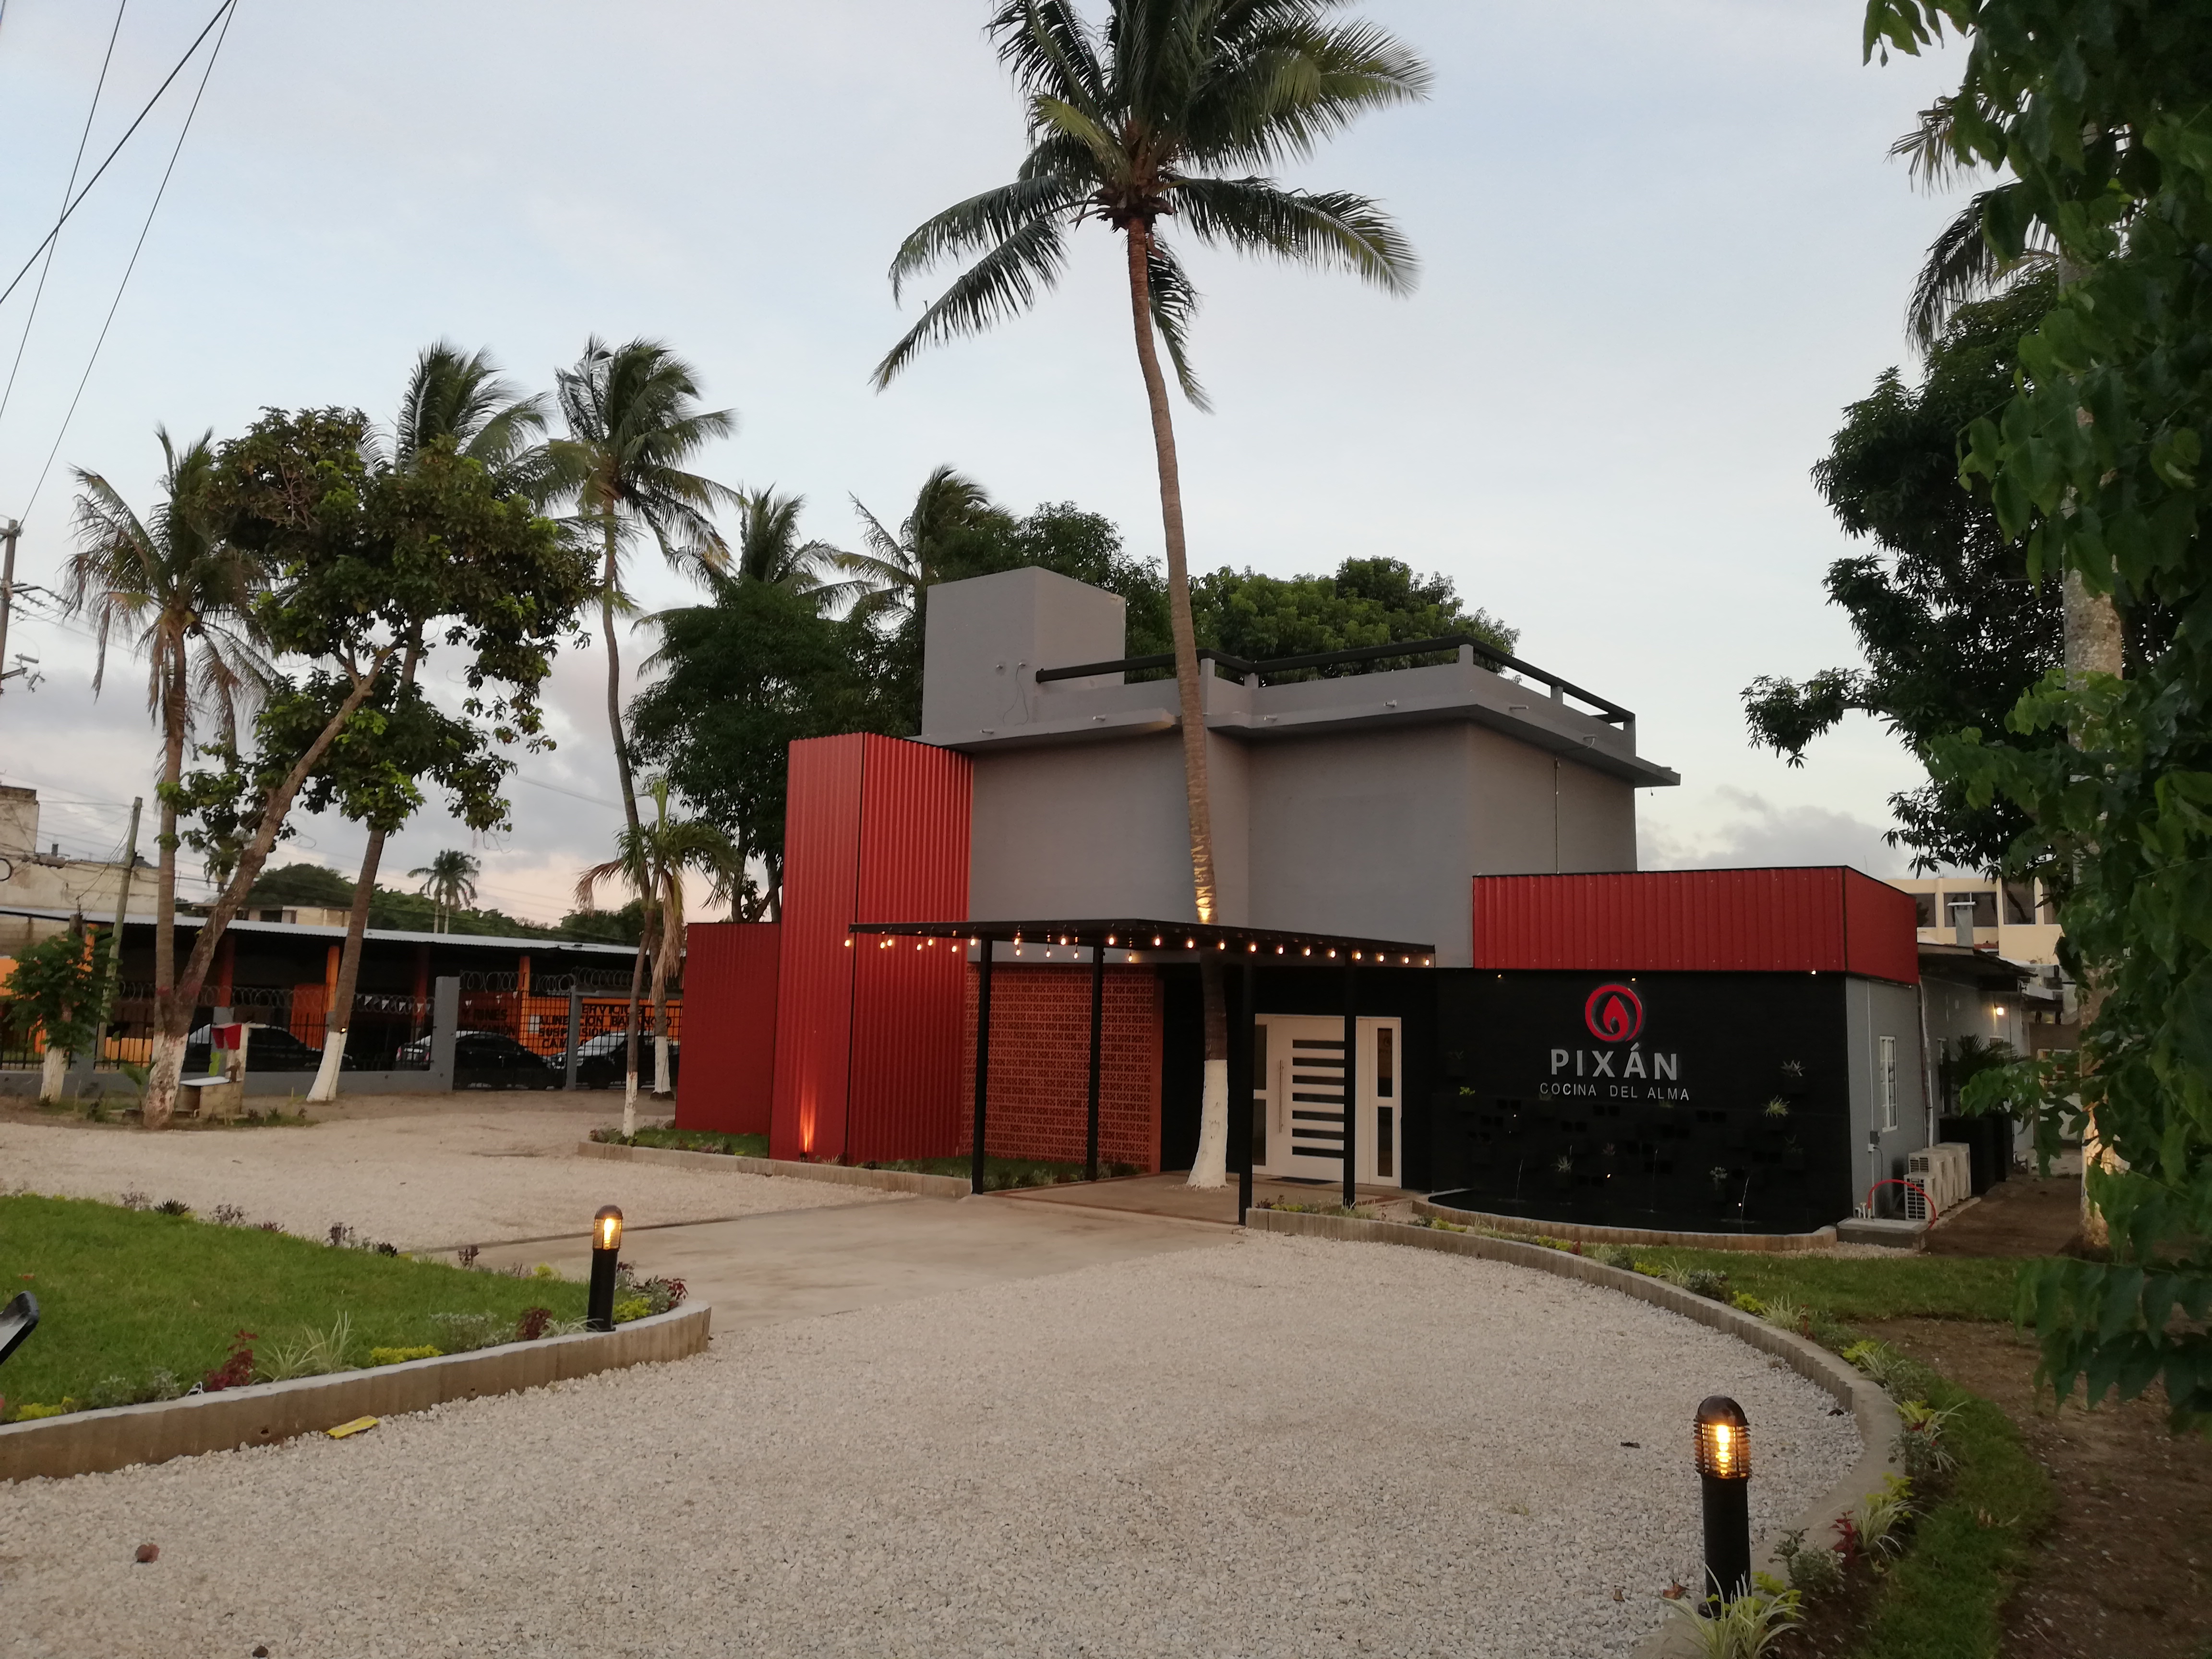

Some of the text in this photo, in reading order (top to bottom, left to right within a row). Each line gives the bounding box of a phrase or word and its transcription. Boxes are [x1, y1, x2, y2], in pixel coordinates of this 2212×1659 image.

[1551, 1042, 1677, 1081] PIXÁN
[1540, 1082, 1689, 1101] COCINA DEL ALMA
